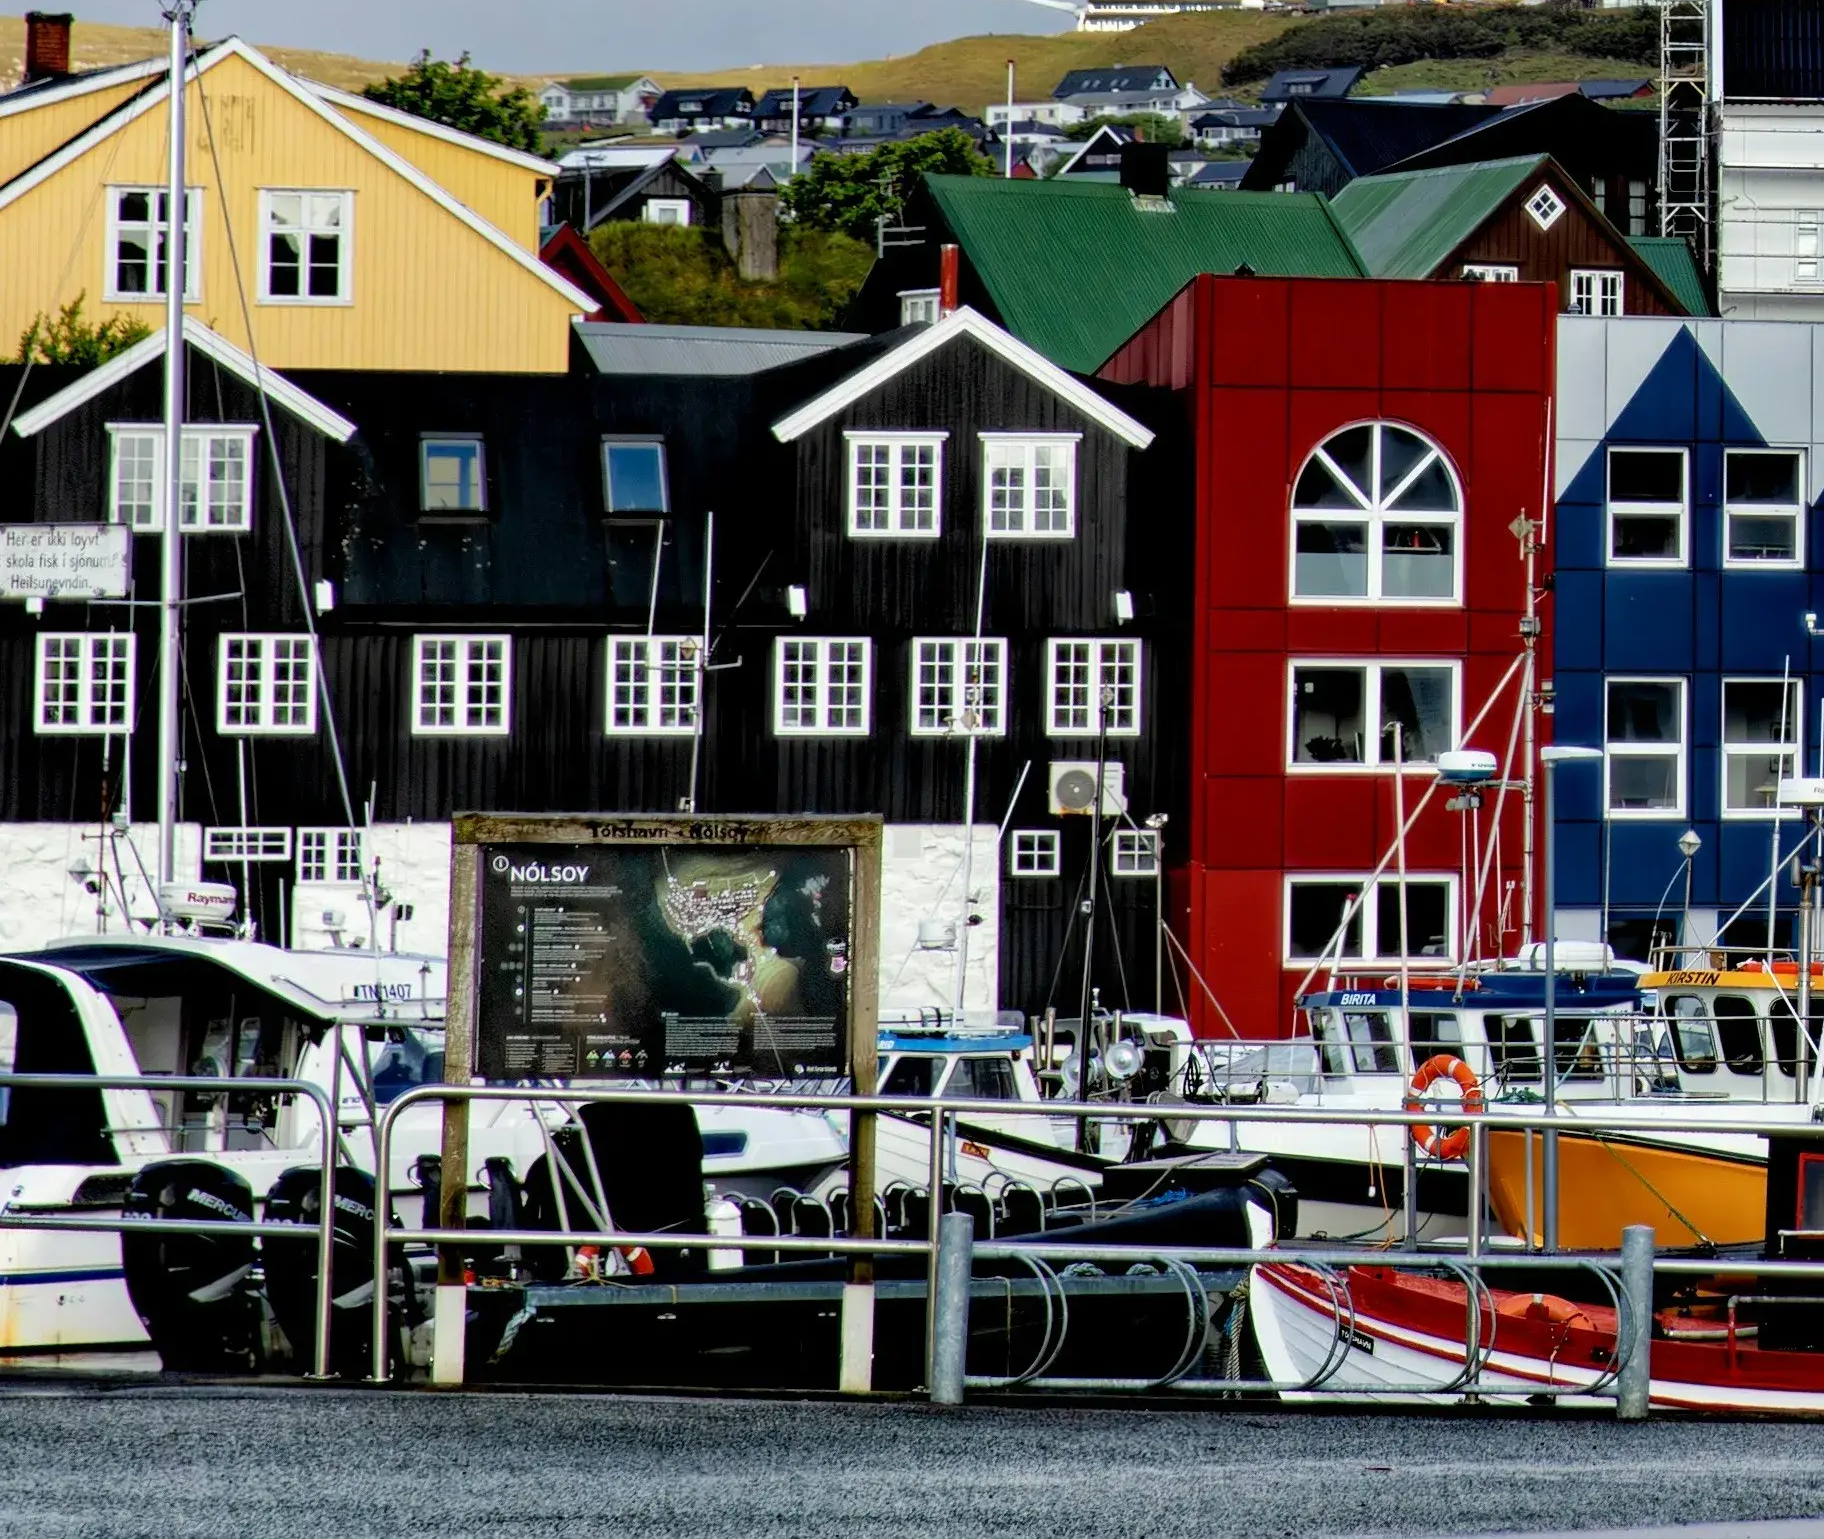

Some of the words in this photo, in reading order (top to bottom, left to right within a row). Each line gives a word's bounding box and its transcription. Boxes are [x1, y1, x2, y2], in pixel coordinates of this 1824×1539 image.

[6, 531, 26, 547] Her
[39, 553, 58, 568] fisk
[590, 823, 668, 839] Tórshavn
[690, 821, 751, 843] Nólsoy
[510, 861, 589, 882] NÓLSOY
[1667, 971, 1720, 986] KIRSTIN
[382, 984, 412, 999] 1407
[1340, 993, 1376, 1006] BIRITA
[333, 1194, 375, 1221] MERC
